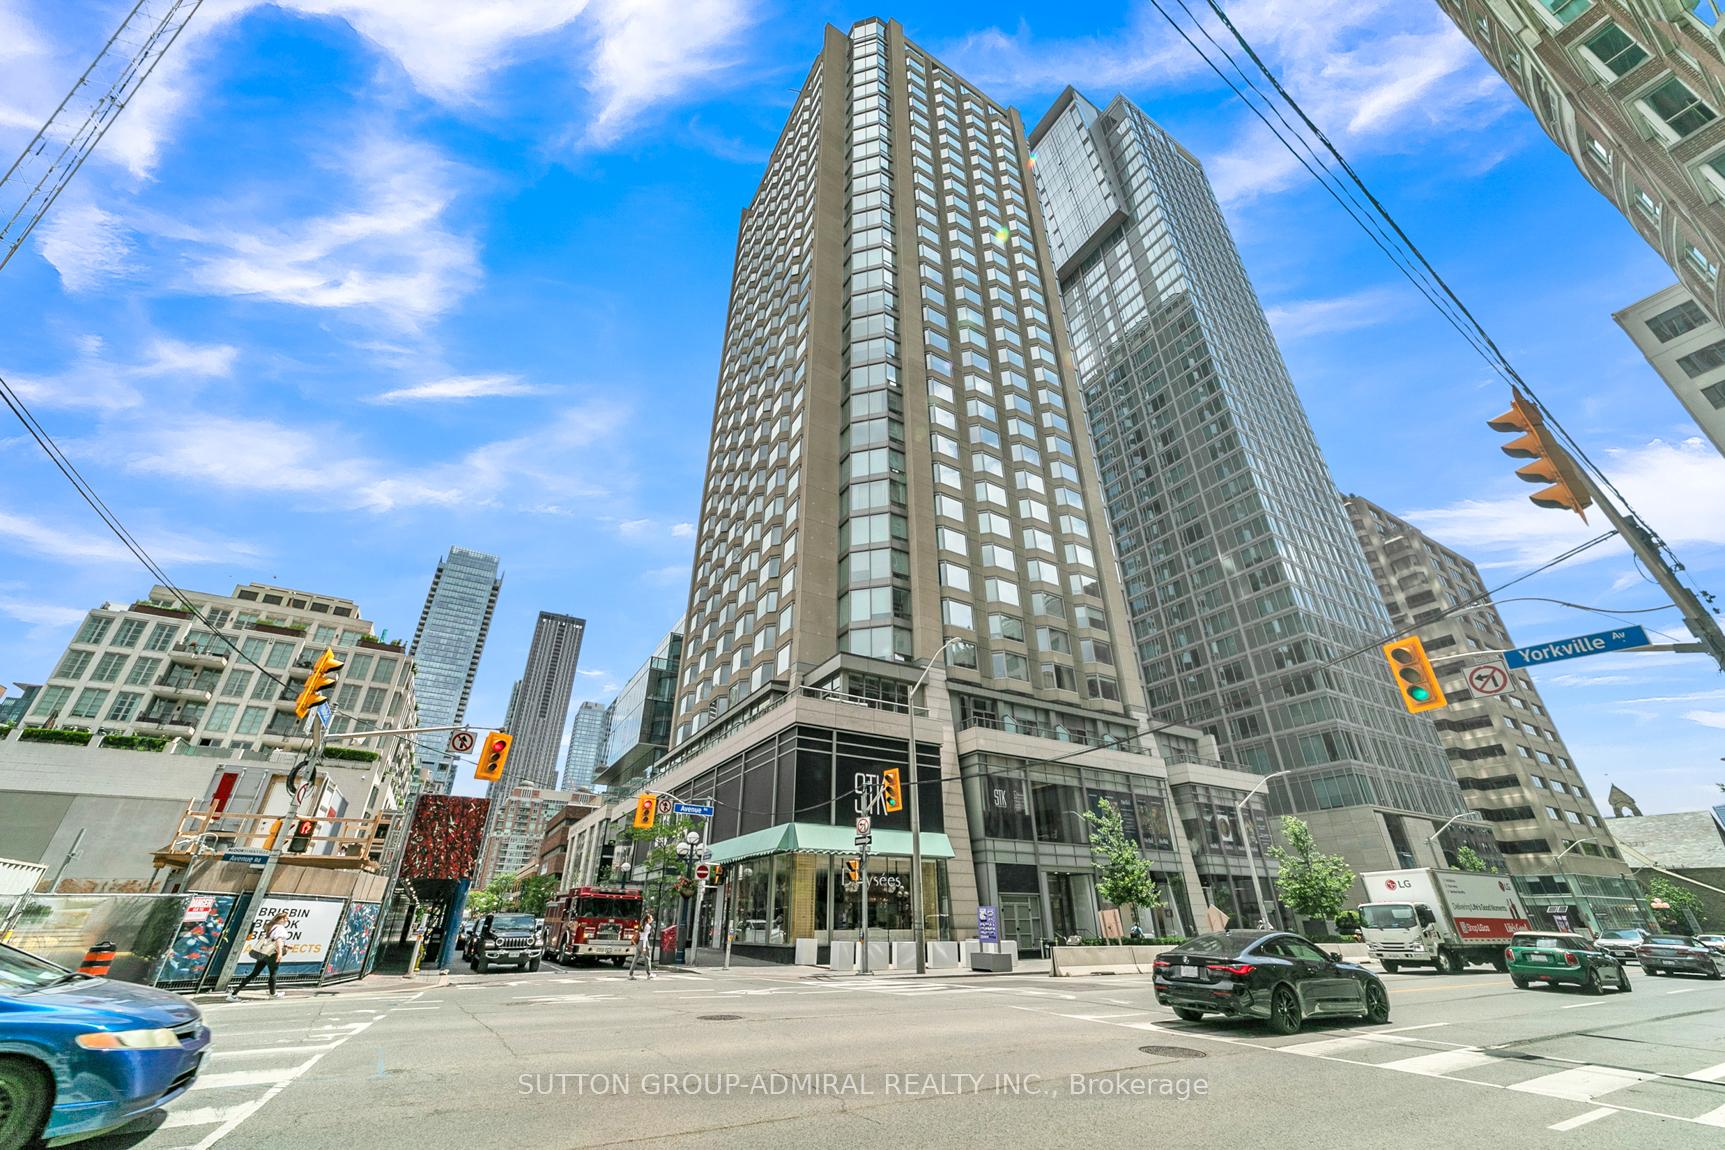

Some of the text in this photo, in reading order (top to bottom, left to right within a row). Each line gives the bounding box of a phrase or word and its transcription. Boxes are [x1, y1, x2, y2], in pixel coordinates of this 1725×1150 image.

[1518, 631, 1625, 663] Yorkville Av
[993, 788, 1007, 806] STK
[680, 805, 702, 814] Avenue
[229, 854, 253, 863] Avenue
[1397, 879, 1412, 889] LG
[258, 907, 310, 918] BRISBIN
